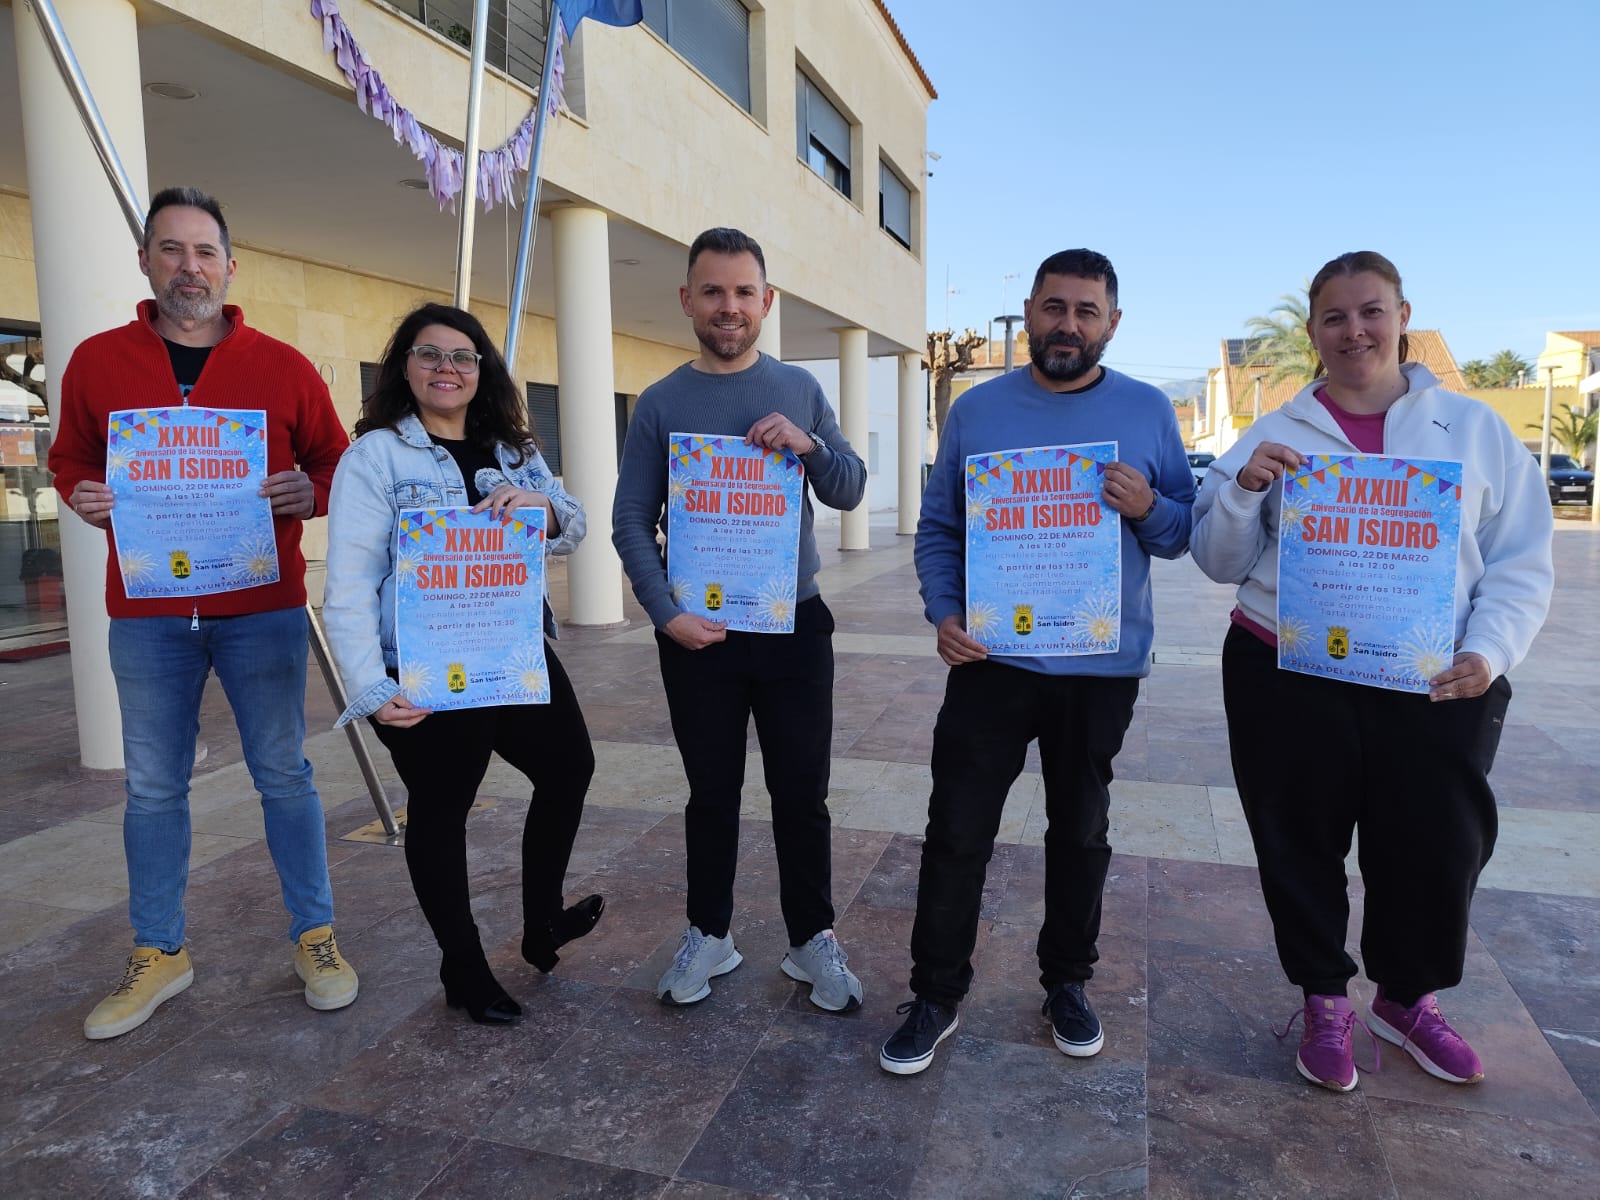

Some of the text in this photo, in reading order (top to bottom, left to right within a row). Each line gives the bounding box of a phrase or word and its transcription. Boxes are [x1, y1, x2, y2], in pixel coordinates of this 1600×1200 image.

[158, 427, 220, 447] XXXIII
[129, 458, 248, 481] SAN ISIDRO
[711, 457, 764, 481] XXXIII
[1012, 468, 1071, 494] XXXIII
[686, 489, 785, 516] SAN ISIDRO
[1031, 494, 1040, 502] de
[1337, 478, 1408, 507] XXXIII
[156, 513, 183, 521] partir
[986, 502, 1100, 531] SAN ISIDRO
[1311, 503, 1356, 513] Aniversario
[1359, 507, 1368, 515] de
[446, 528, 503, 551] XXXIII
[991, 534, 1036, 543] DOMINGO,
[1302, 516, 1438, 549] SAN ISIDRO
[1308, 548, 1360, 558] DOMINGO,
[1363, 551, 1374, 559] 22
[1392, 553, 1429, 562] MARZO
[417, 563, 526, 589] SAN ISIDRO
[1006, 565, 1032, 573] partir
[195, 575, 268, 590] AYUNTAMIENTO
[1322, 582, 1352, 590] partir
[984, 642, 1010, 650] LAZA
[1035, 641, 1106, 649] AYUNTAMIENTO
[1372, 649, 1398, 658] Isidro
[1290, 660, 1430, 686] PLAZA DEL AYUNTAMIENT
